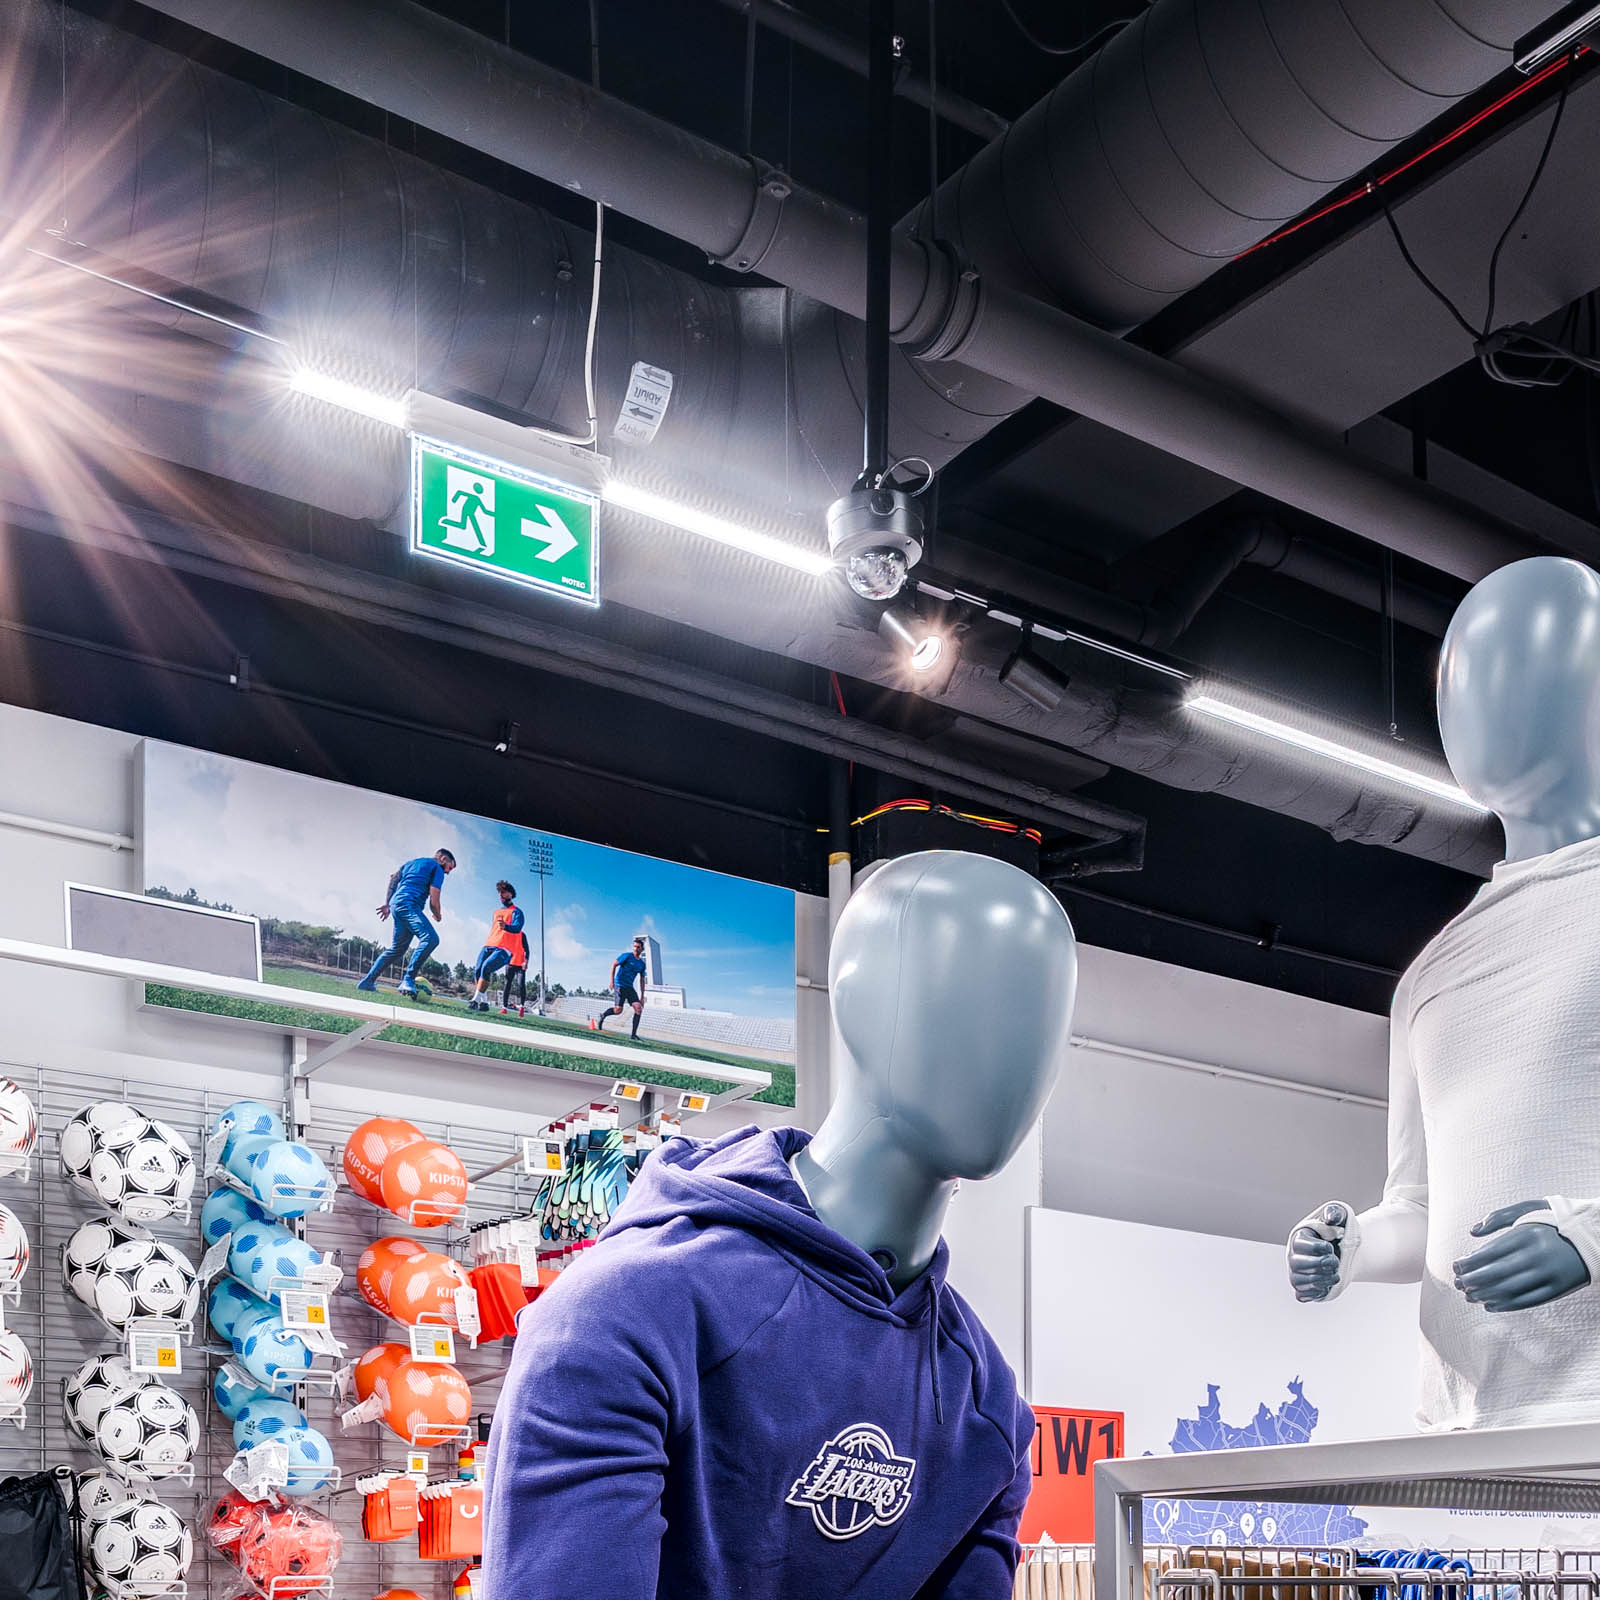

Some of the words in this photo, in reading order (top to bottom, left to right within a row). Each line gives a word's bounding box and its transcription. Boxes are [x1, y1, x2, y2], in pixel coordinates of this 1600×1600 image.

[140, 1166, 165, 1174] adidas
[346, 1150, 380, 1186] KIPSTA
[428, 1171, 466, 1189] KIPSTA
[161, 1352, 171, 1361] 27
[1052, 1417, 1115, 1476] W1
[843, 1456, 865, 1471] LOS
[864, 1459, 909, 1478] ANGELES
[801, 1453, 905, 1518] LAKERS
